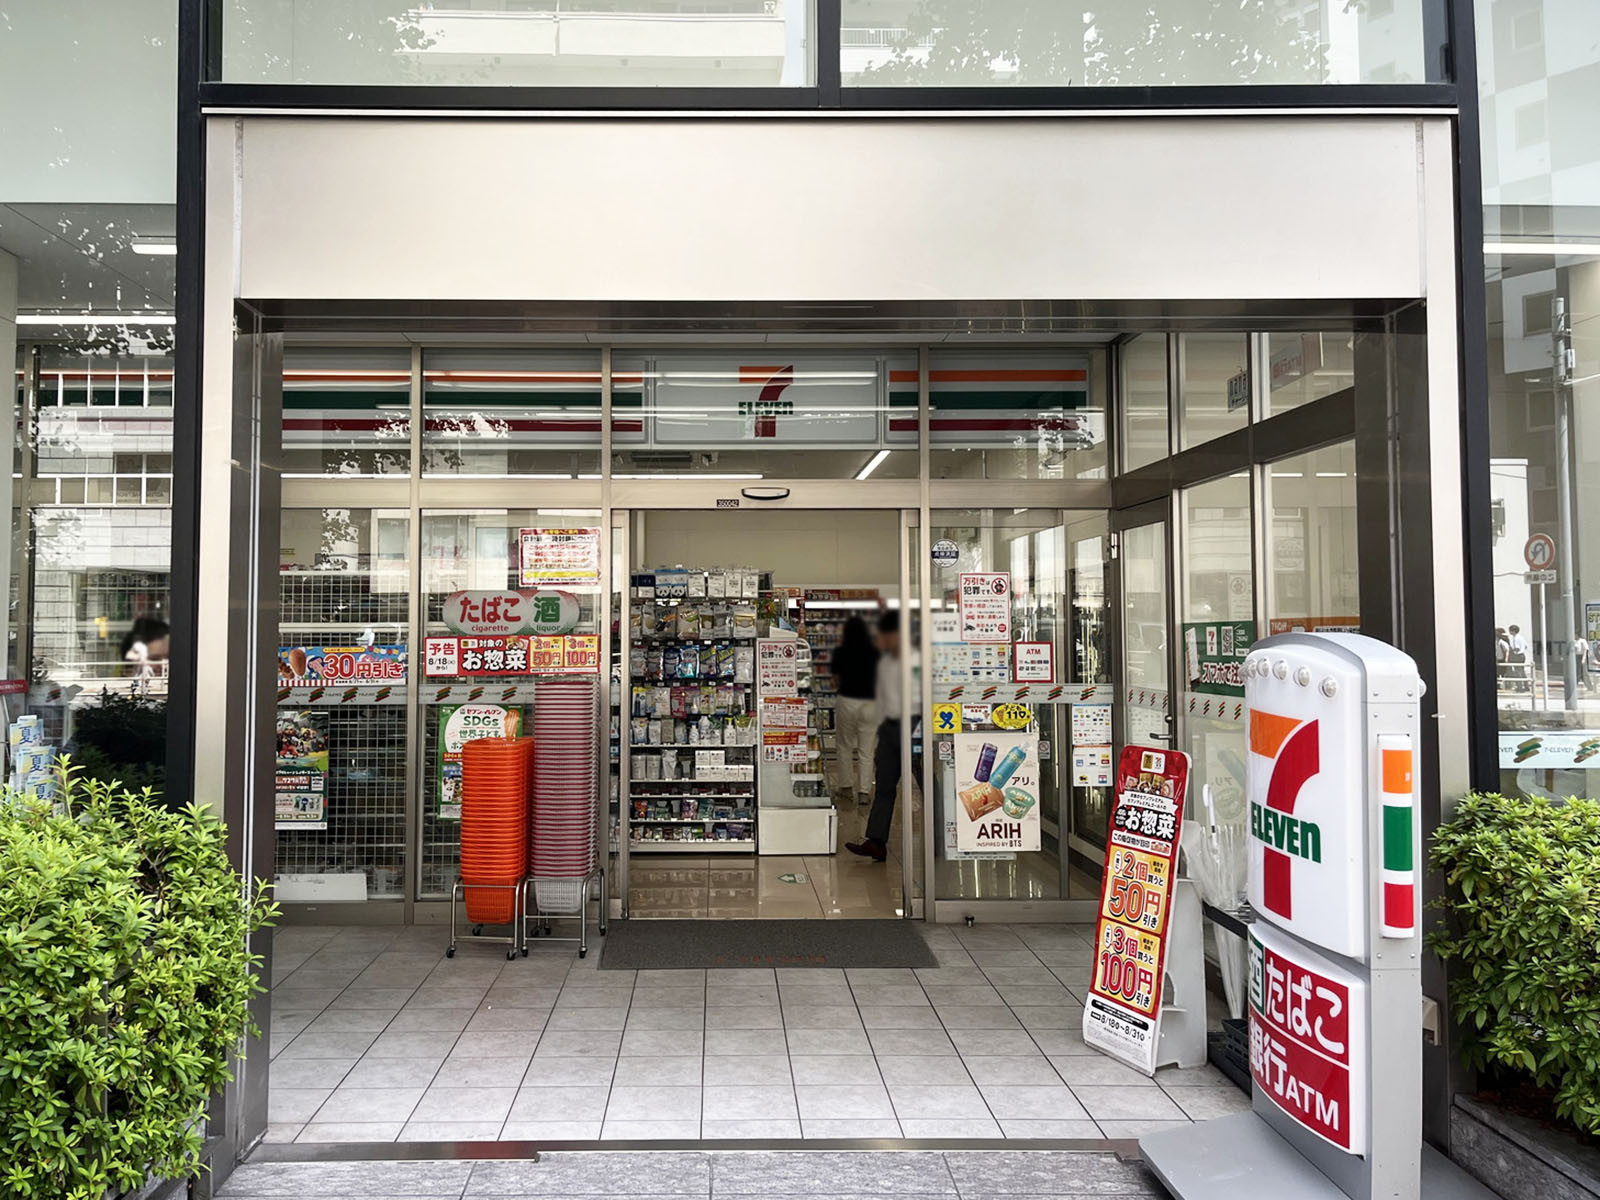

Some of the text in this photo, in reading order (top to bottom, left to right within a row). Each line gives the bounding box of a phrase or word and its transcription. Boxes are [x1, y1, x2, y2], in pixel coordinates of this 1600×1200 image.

[460, 595, 561, 623] たばこ 酒
[471, 624, 561, 633] cigarette liquor
[429, 642, 455, 655] 予告
[478, 640, 503, 648] 対象の
[323, 653, 404, 679] 30円引き
[462, 648, 527, 671] お惣菜
[1202, 662, 1245, 686] スマホで注
[463, 715, 499, 727] SDGs
[976, 822, 1022, 840] ARIH
[1125, 807, 1176, 840] お惣菜
[1009, 840, 1022, 848] BTS
[1266, 956, 1345, 1055] たばこ
